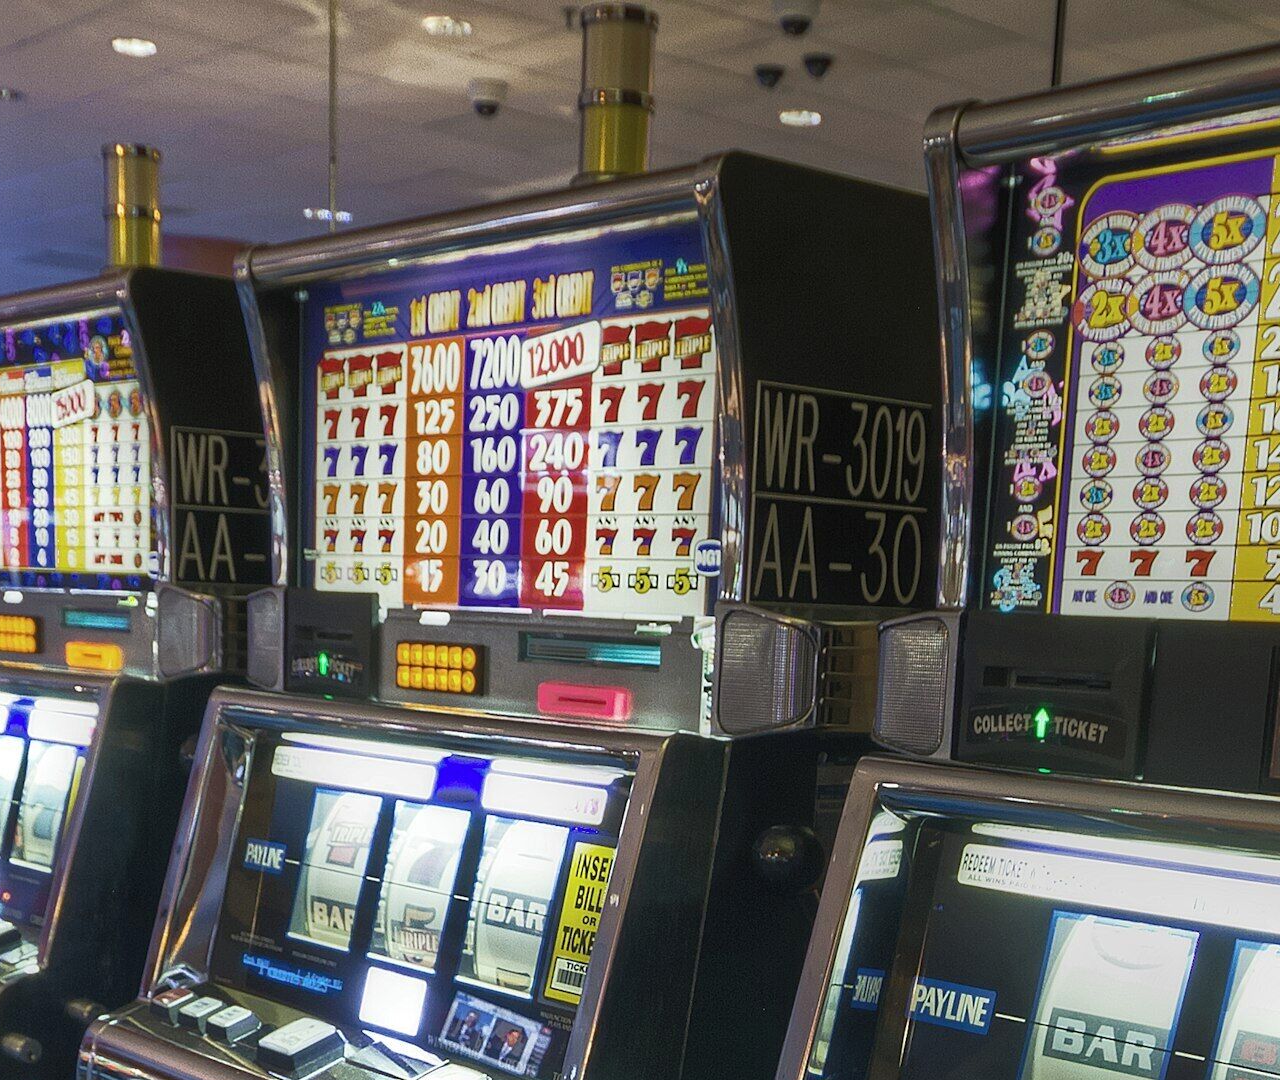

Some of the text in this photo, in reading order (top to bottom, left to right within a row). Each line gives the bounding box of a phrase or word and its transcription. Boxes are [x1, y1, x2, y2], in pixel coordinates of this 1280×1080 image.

[410, 341, 461, 395] 3600
[469, 333, 521, 390] 7200
[414, 387, 584, 435] 125 250 375
[415, 431, 585, 476] 80 160 240
[764, 388, 927, 504] WR-3019
[416, 475, 574, 515] 30 60 90
[415, 518, 573, 555] 20 40 60
[754, 502, 922, 605] AA-30
[418, 558, 570, 597] 15 30 45
[973, 713, 1109, 744] COLLECT TICKET
[245, 843, 284, 869] PAYLINE
[961, 853, 996, 874] REDEEM
[488, 891, 547, 931] BAR
[910, 983, 990, 1027] PAYLINE
[1051, 1016, 1157, 1070] BAR
